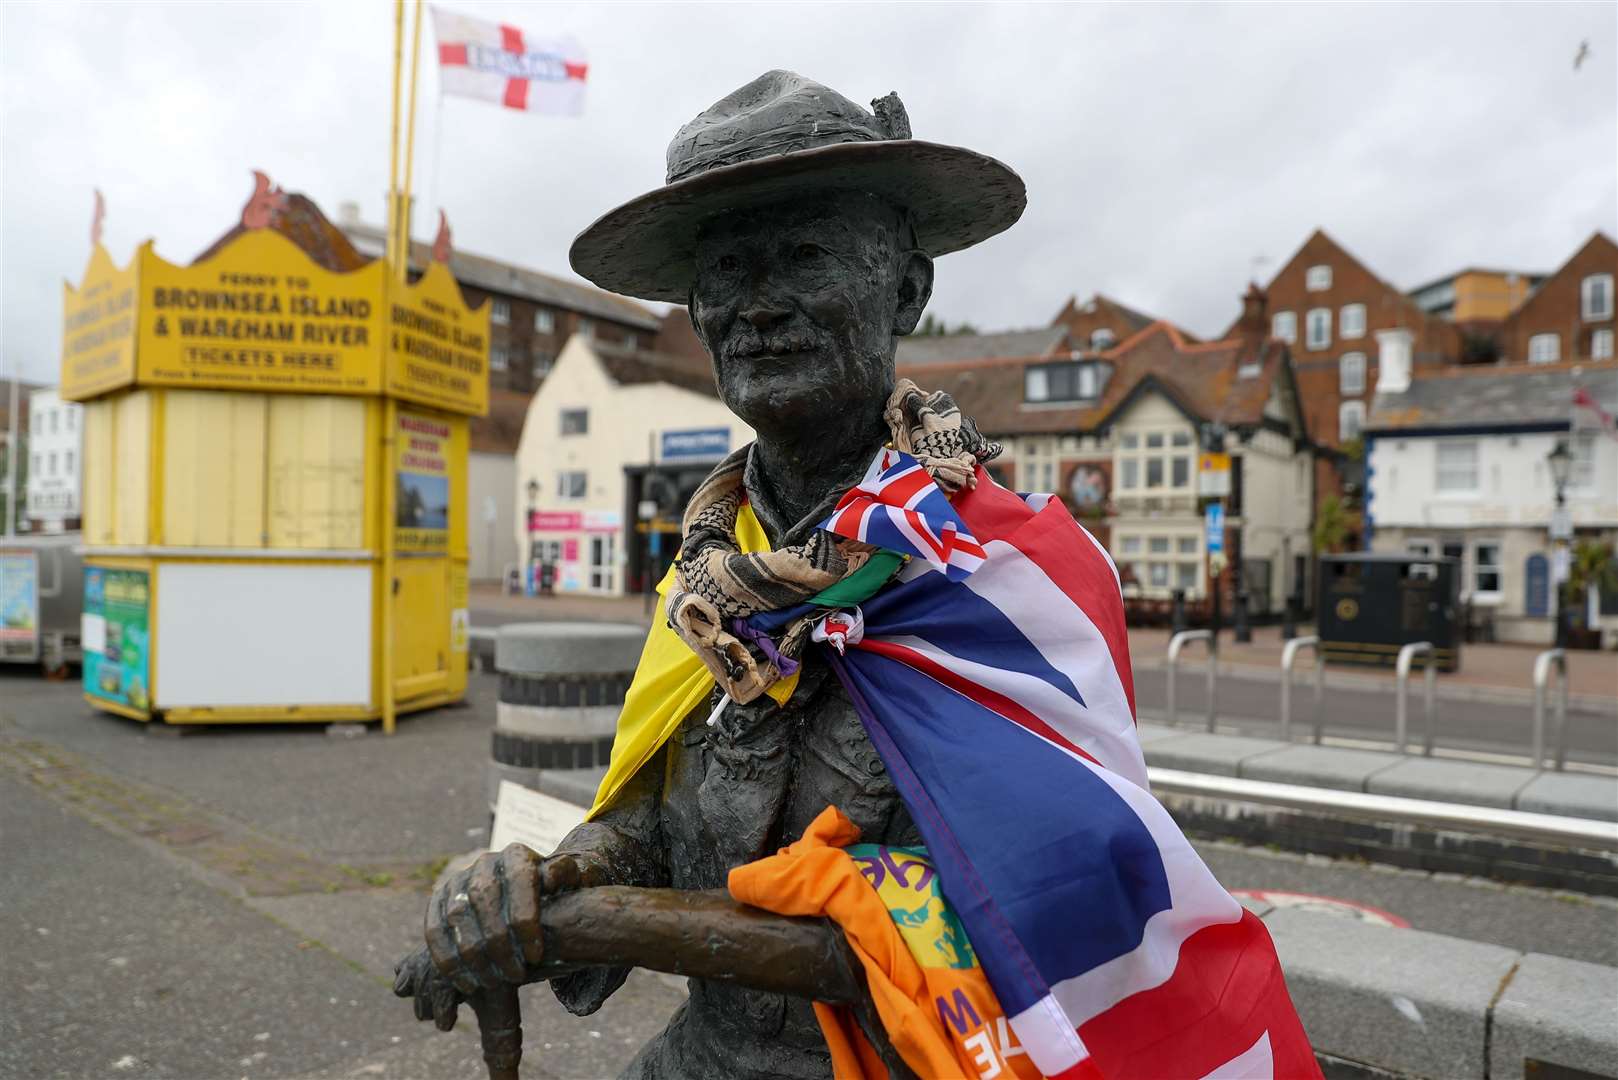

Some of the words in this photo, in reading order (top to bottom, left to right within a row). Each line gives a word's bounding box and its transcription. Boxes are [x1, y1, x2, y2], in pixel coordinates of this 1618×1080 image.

[220, 272, 277, 287] FERRY
[286, 277, 309, 289] TO
[154, 287, 282, 314] BROWNSEA
[290, 294, 371, 319] ISLAND
[155, 315, 168, 336] &
[179, 317, 294, 341] WAREHAM
[303, 323, 369, 347] RIVER
[187, 347, 276, 368] TICKETS
[283, 352, 335, 370] HERE
